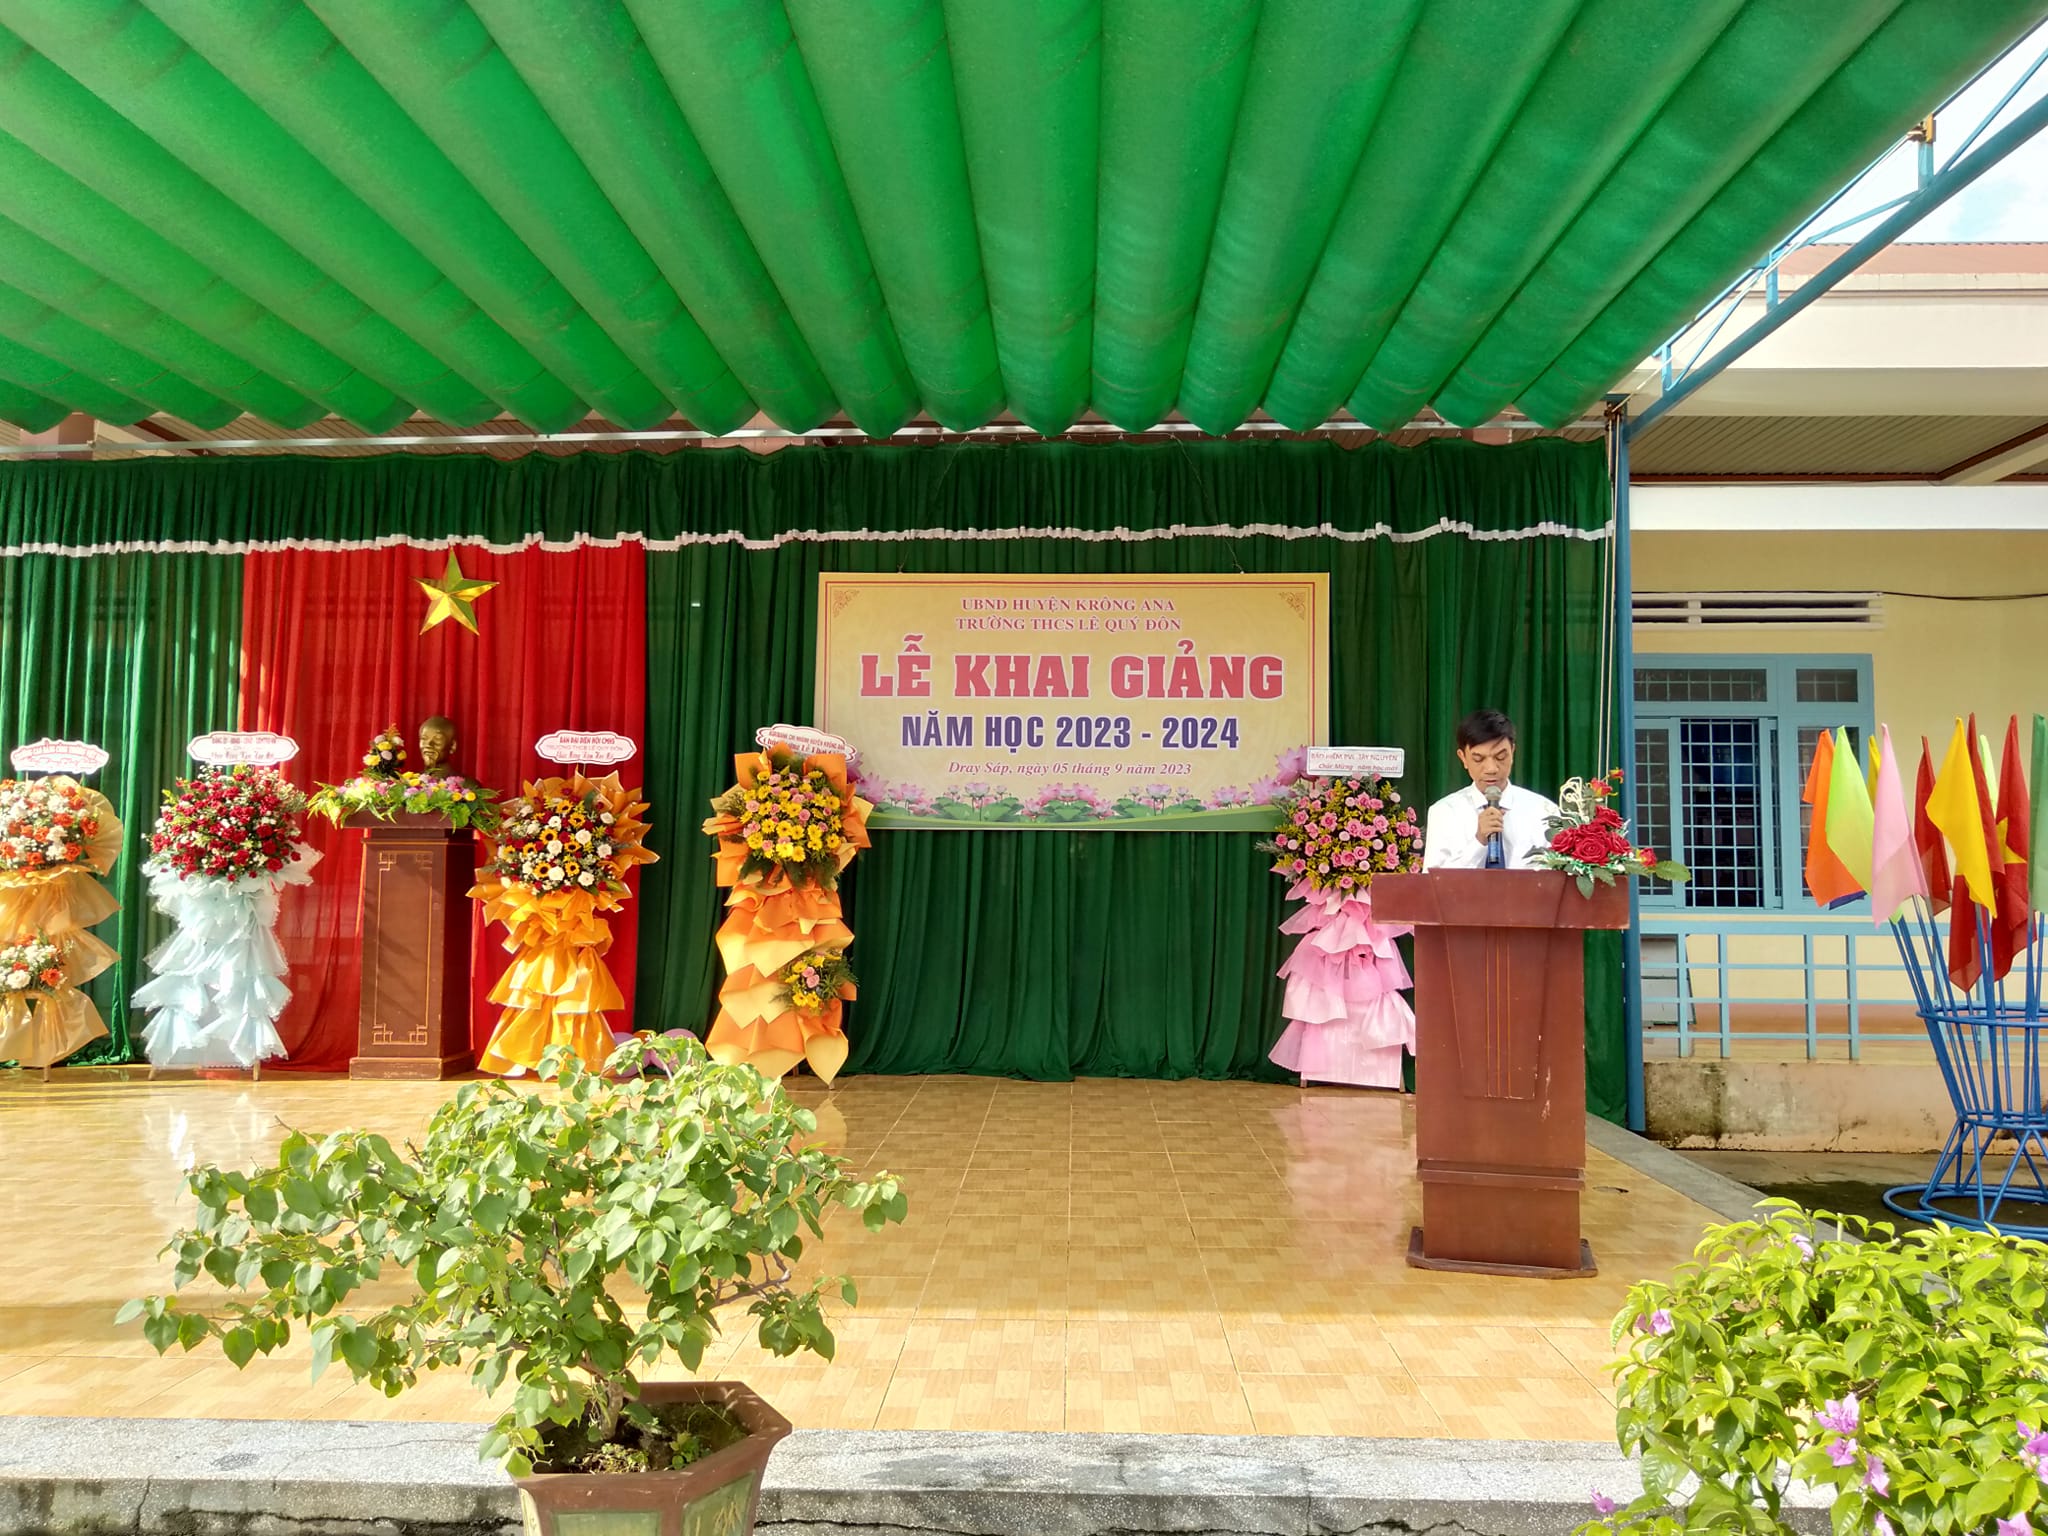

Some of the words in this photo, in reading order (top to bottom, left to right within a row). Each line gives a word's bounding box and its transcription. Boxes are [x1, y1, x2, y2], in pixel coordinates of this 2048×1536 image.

[962, 599, 1007, 611] UBND
[1012, 598, 1071, 612] HUYỆN
[1076, 597, 1136, 611] KRÔNG
[1141, 600, 1175, 611] ANA
[956, 616, 1025, 630] TRƯỜNG
[1031, 618, 1074, 630] THCS
[1079, 616, 1099, 630] LÊ
[1105, 616, 1138, 633] QUÝ
[1145, 616, 1181, 630] ĐÔN
[860, 635, 931, 697] LỄ
[954, 655, 1090, 698] KHAI
[1111, 640, 1283, 699] GIẢNG
[902, 710, 973, 746] NĂM
[985, 716, 1044, 753] HỌC
[1056, 717, 1131, 748] 2023
[1162, 718, 1239, 748] 2024
[1016, 764, 1049, 776] ngày
[1052, 763, 1068, 774] 05
[1072, 762, 1110, 776] tháng
[1115, 764, 1122, 774] 9
[1126, 765, 1156, 775] năm
[1160, 764, 1192, 775] 2023
